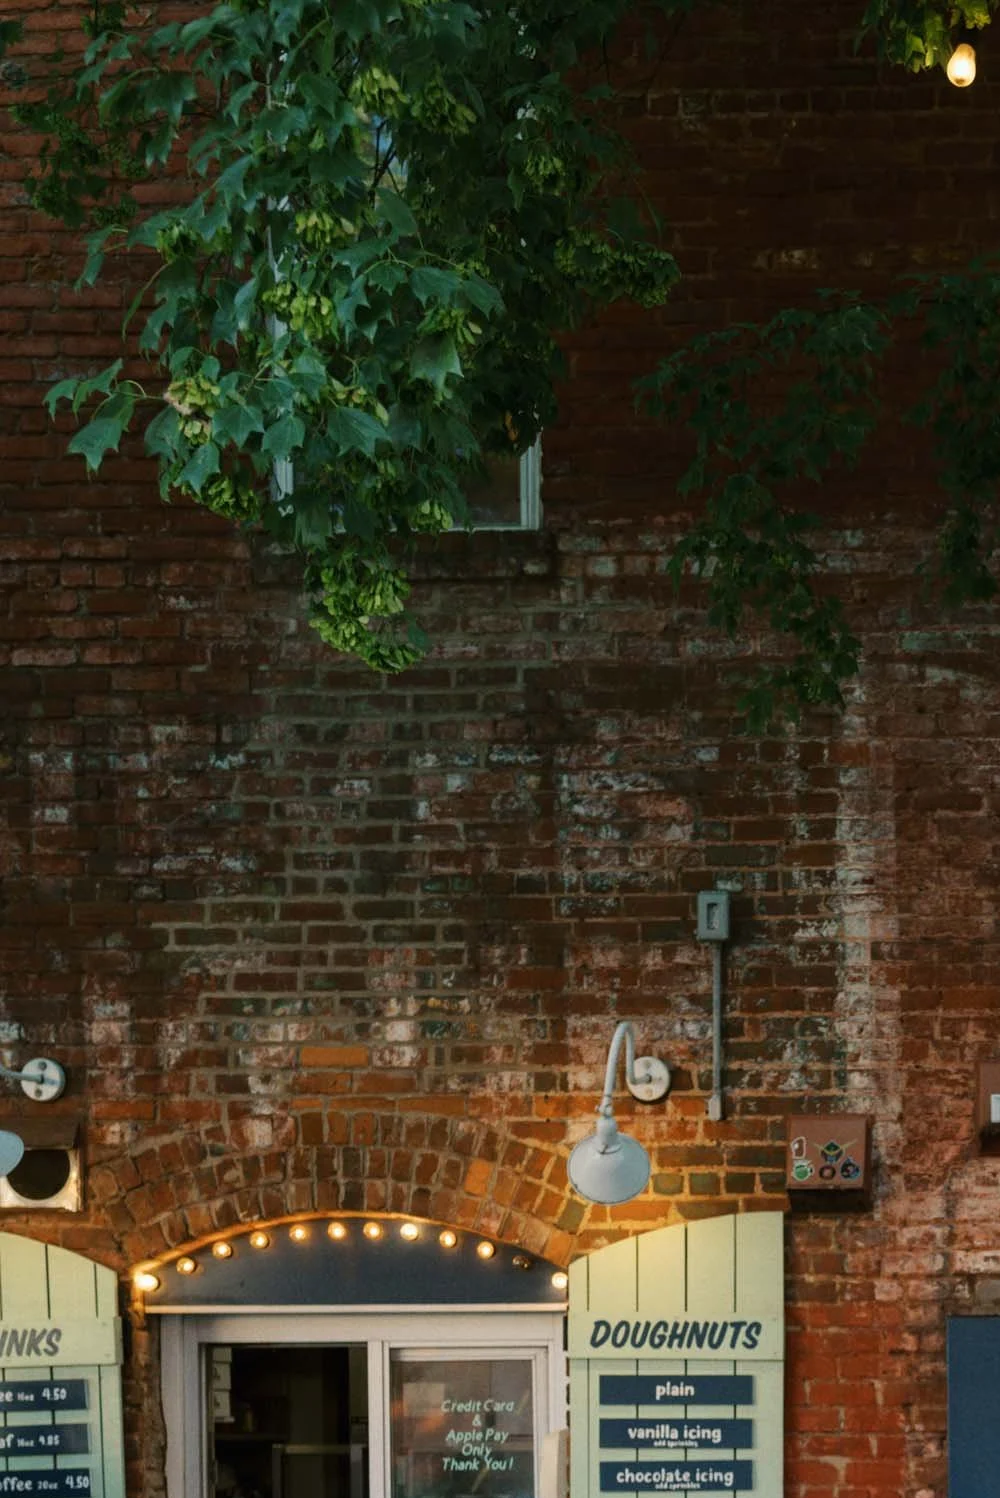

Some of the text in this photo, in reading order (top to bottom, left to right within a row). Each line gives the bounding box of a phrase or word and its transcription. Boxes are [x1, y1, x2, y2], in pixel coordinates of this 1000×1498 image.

[590, 1319, 762, 1350] DOUGHNUTS
[655, 1381, 695, 1401] plain
[441, 1399, 514, 1413] Credit Card
[471, 1413, 482, 1427] &
[445, 1427, 509, 1445] Apple Pay
[627, 1424, 722, 1443] vanilla icing
[462, 1442, 493, 1459] Only
[442, 1457, 480, 1471] Thank
[616, 1468, 734, 1487] chocolate icing
